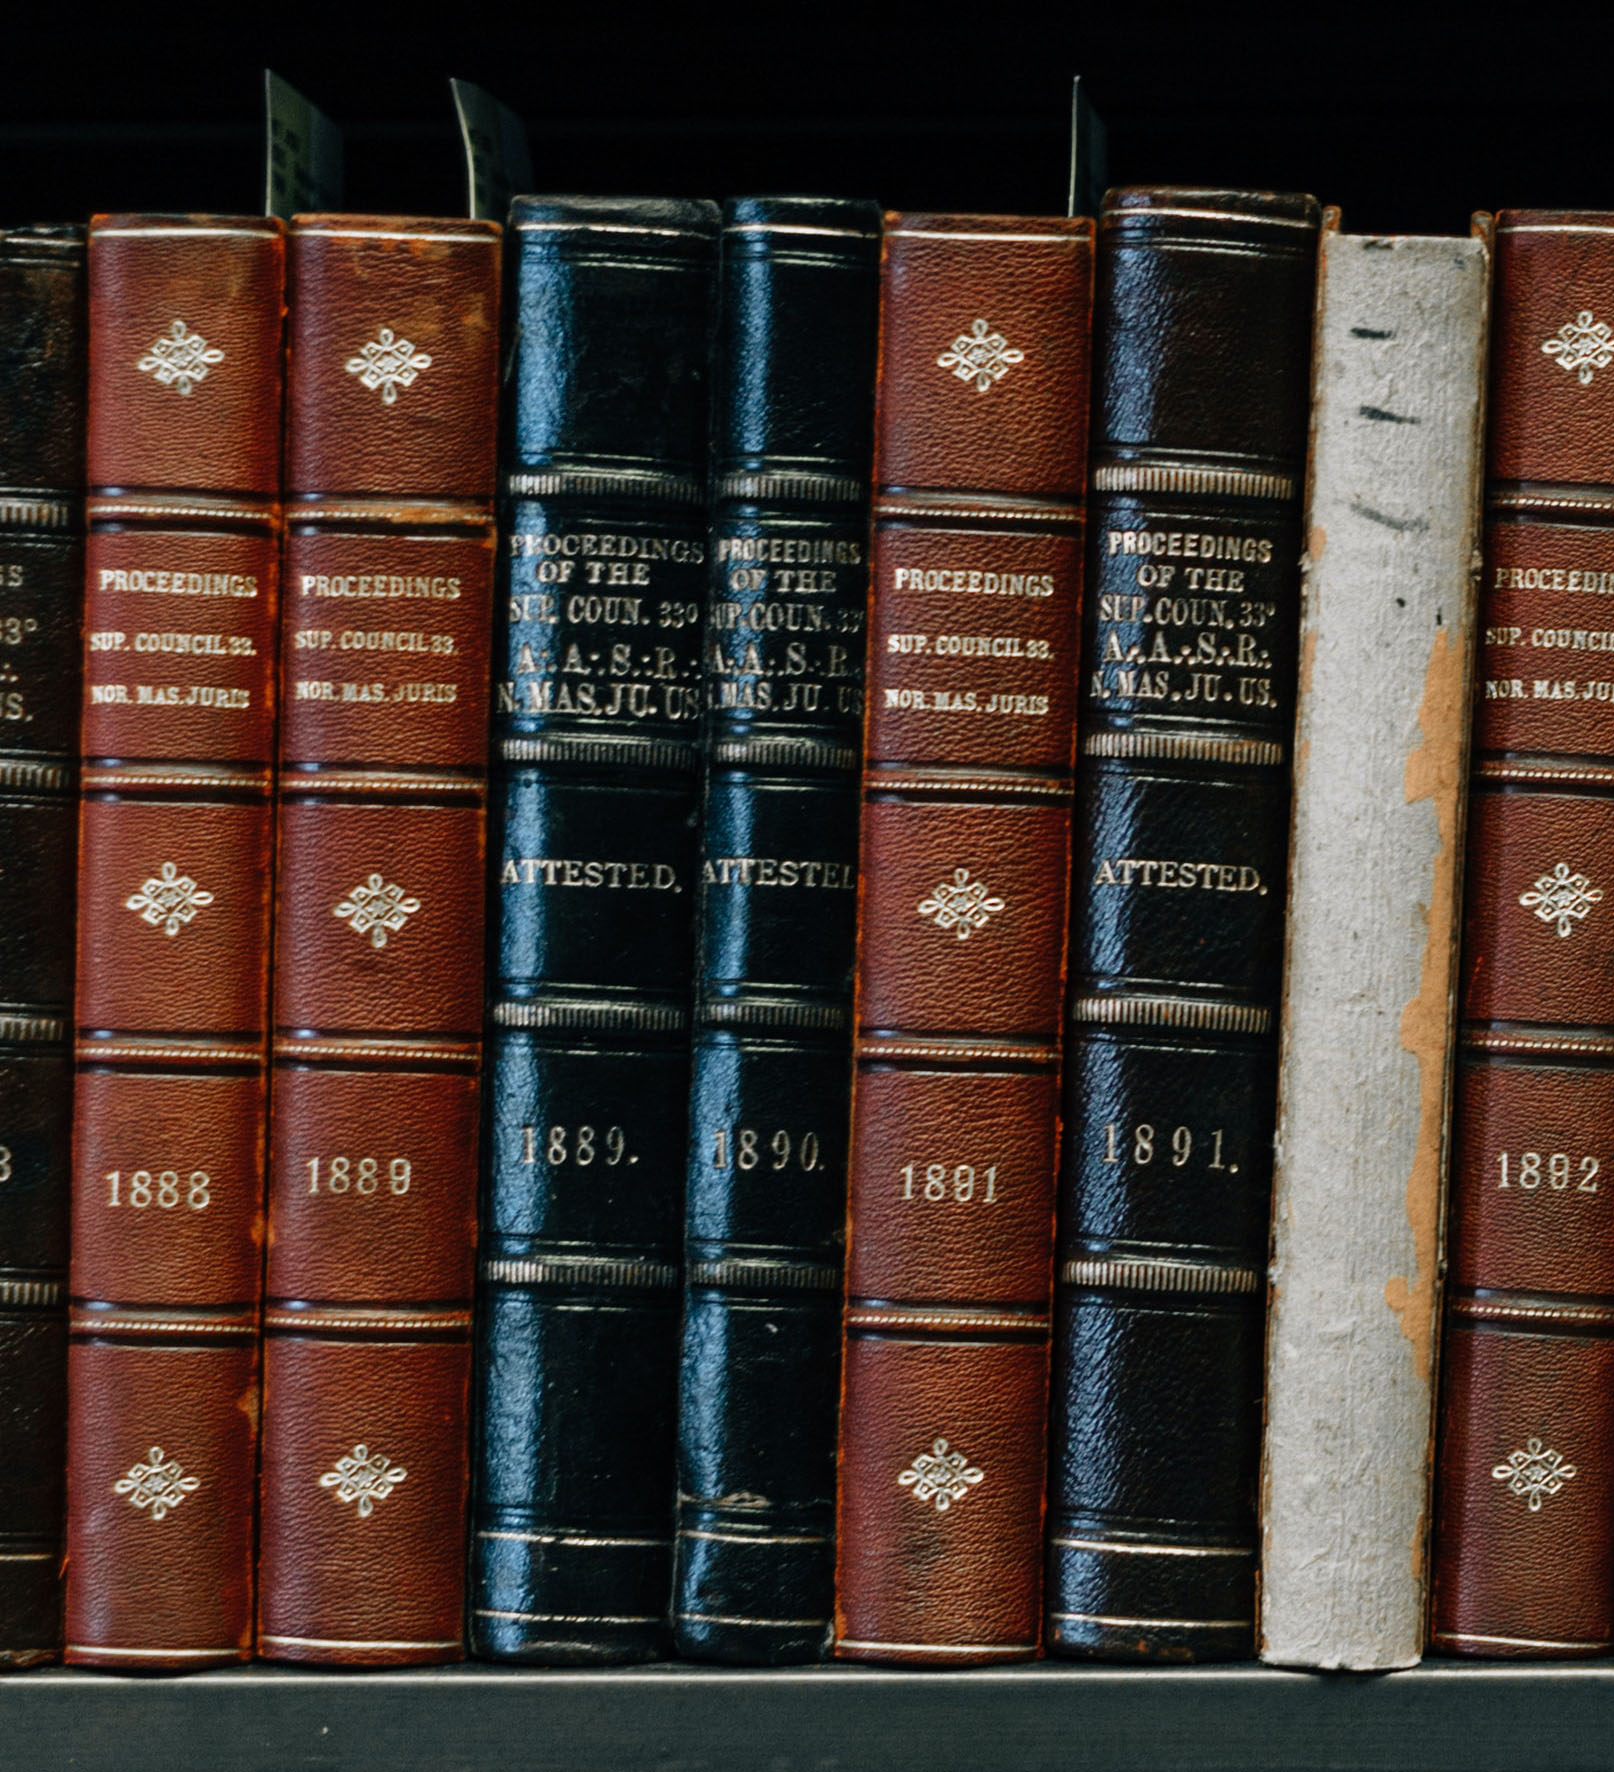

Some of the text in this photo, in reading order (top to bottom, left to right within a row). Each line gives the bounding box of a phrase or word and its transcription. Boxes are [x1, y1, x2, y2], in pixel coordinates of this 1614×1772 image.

[509, 534, 705, 565] PROCEEDINGS
[718, 537, 862, 565] PROCEEDINGS
[1106, 531, 1274, 563] PROCEEDINGS
[99, 569, 258, 598] PROCEEDINGS
[301, 575, 462, 599] PROCEEDINGS
[536, 560, 651, 586] OF THE
[729, 568, 838, 593] OF THE
[895, 568, 1055, 597] PROCEEDINGS
[1136, 563, 1246, 592] OF THE
[135, 633, 227, 655] COUNCIL
[340, 631, 430, 652] COUNCIL
[935, 635, 1025, 657] COUNCIL
[185, 686, 250, 709] JURIS
[393, 683, 458, 703] JURIS
[984, 694, 1050, 715] JURIS
[500, 857, 683, 893] ATTESTED.
[1096, 858, 1268, 896] ATTESTED.
[521, 1125, 640, 1166] 1889.
[712, 1129, 826, 1172] 1890.
[1102, 1123, 1240, 1175] 1891.
[304, 1156, 412, 1196] 1889
[900, 1163, 1001, 1204] 1891
[1496, 1151, 1601, 1193] 1892
[105, 1170, 211, 1210] 1888
